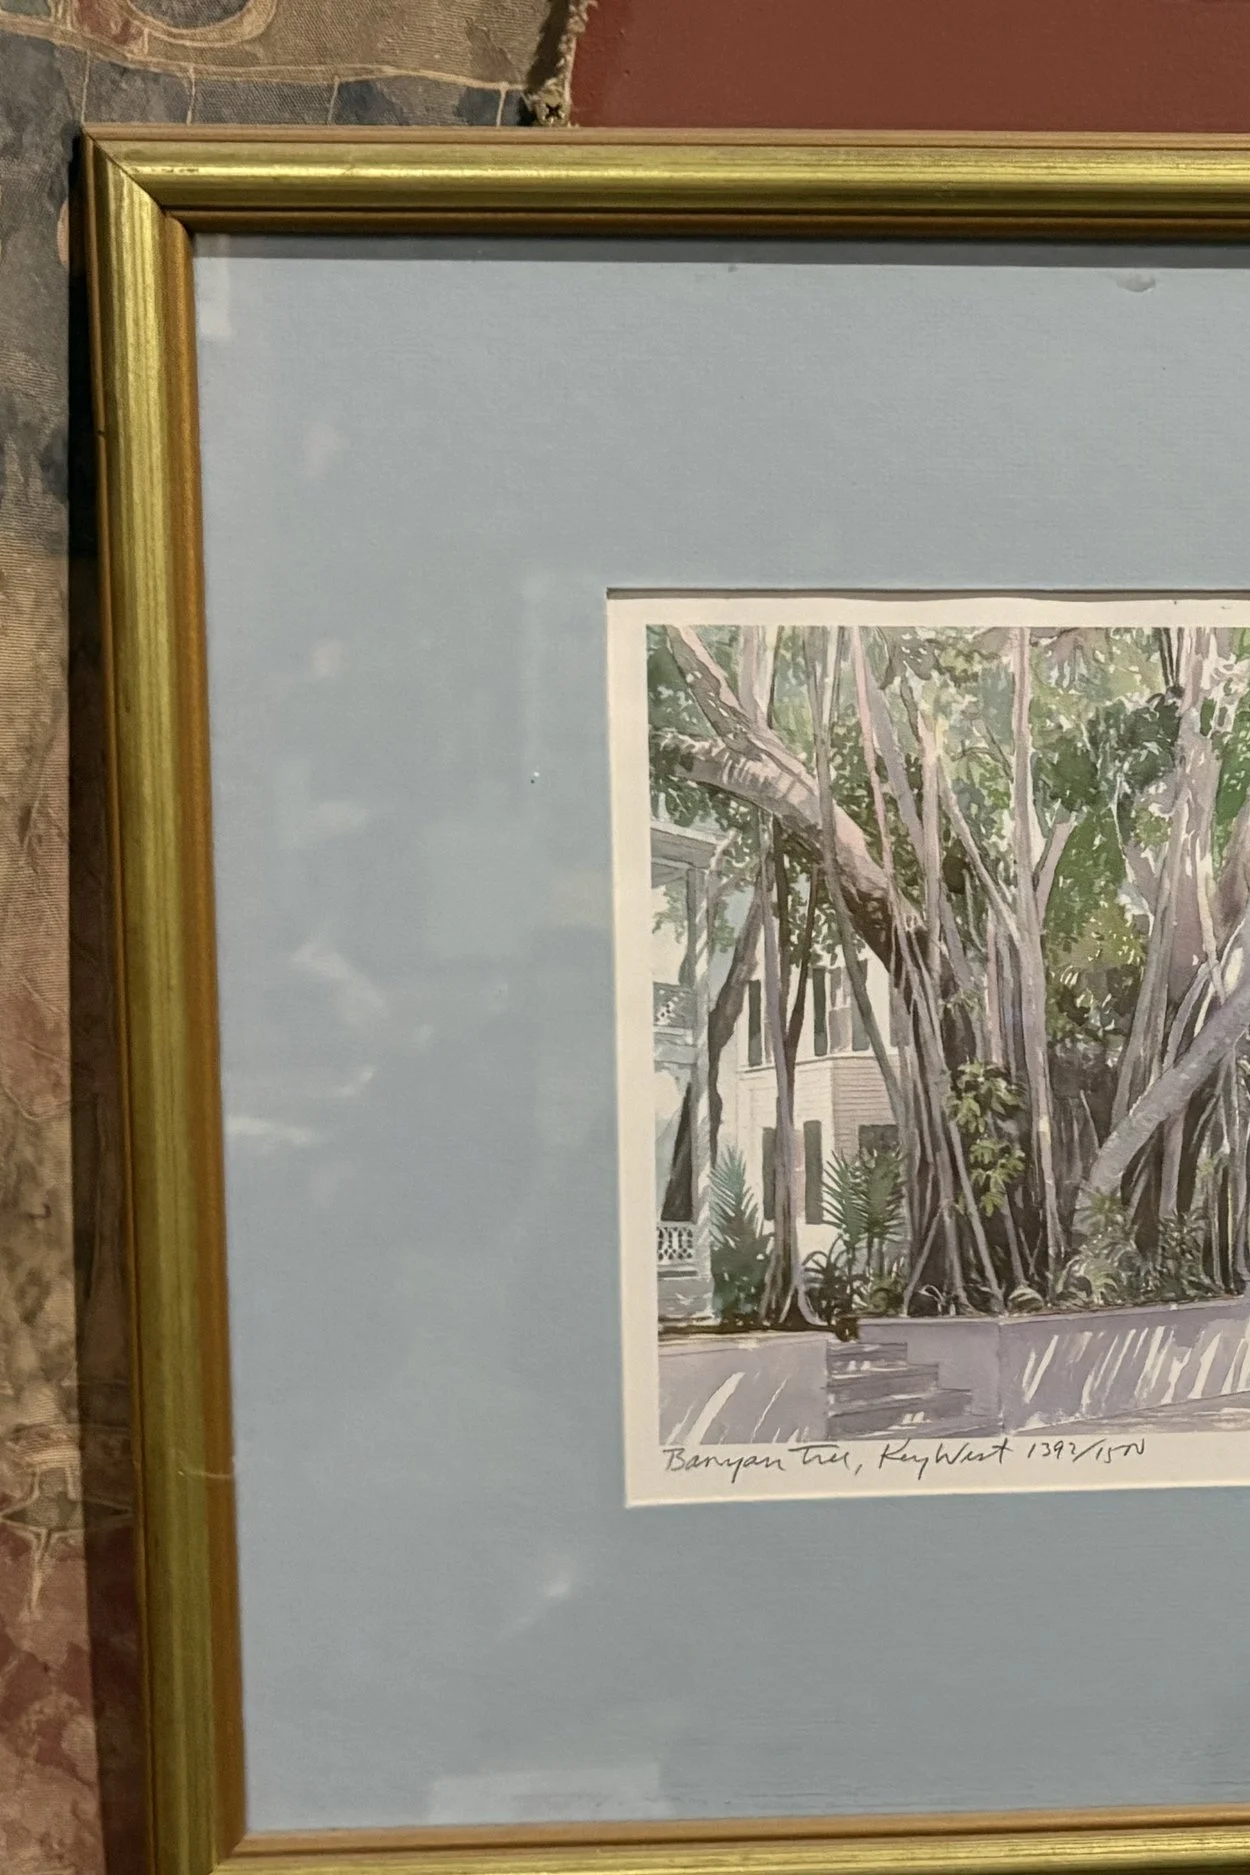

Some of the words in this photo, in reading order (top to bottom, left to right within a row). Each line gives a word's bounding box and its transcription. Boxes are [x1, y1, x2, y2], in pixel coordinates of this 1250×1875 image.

[663, 1447, 786, 1484] Banyan
[879, 1438, 930, 1480] Key
[935, 1437, 1014, 1465] West
